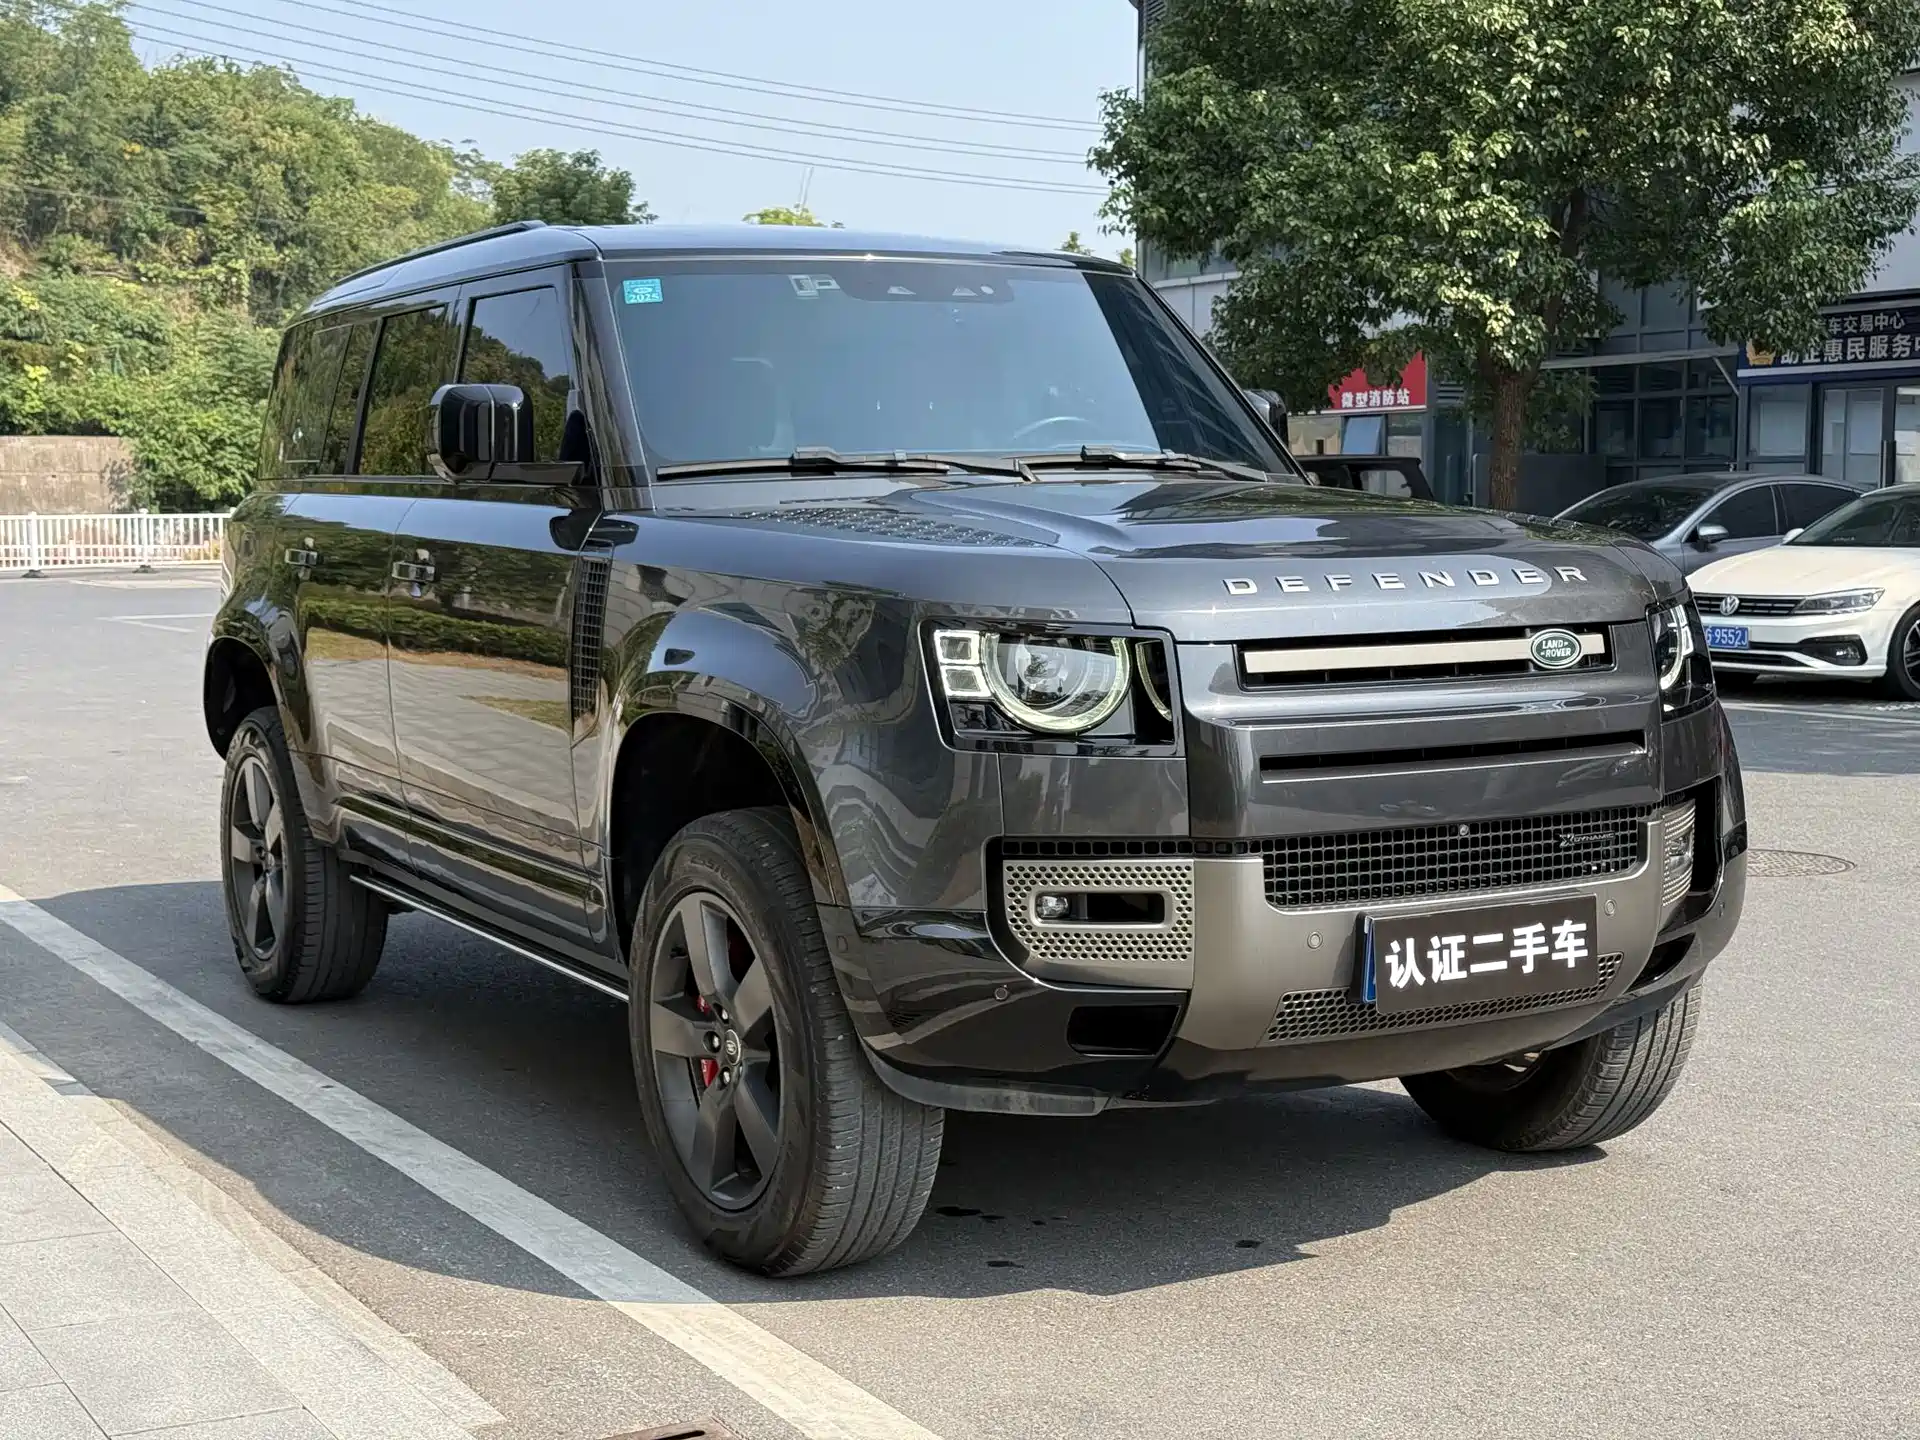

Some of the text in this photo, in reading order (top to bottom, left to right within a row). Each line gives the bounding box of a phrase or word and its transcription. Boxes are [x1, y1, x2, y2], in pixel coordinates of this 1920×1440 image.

[1341, 388, 1410, 409] 微型消防站
[1222, 566, 1588, 596] DEFENDER
[1542, 639, 1564, 649] LAND
[1545, 647, 1572, 658] ROVER
[1385, 919, 1589, 989] 认证二手车
